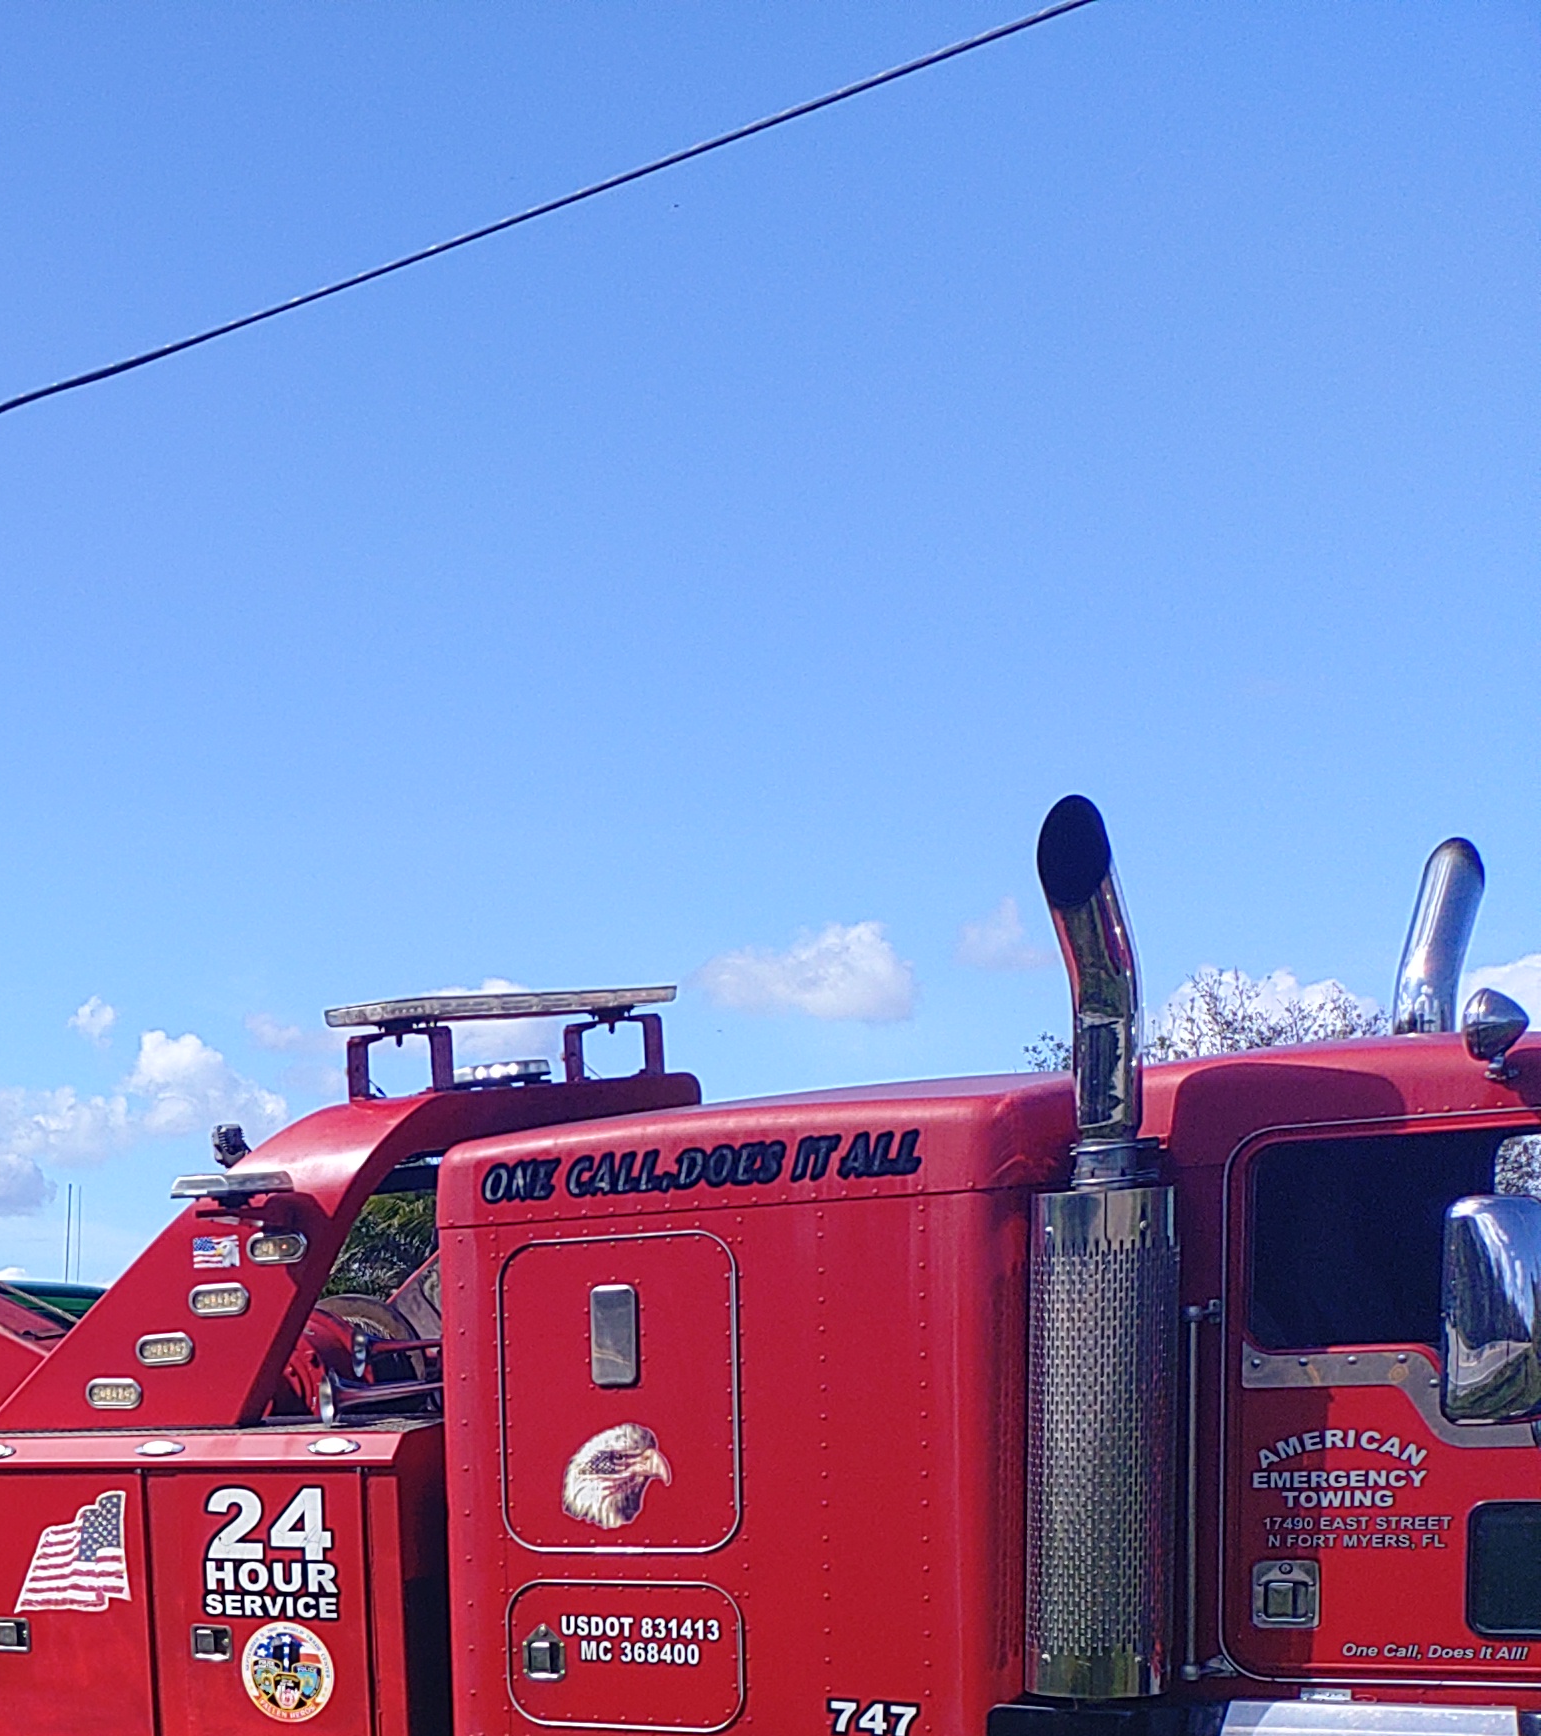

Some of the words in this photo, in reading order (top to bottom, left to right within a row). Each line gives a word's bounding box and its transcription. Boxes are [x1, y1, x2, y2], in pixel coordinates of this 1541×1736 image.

[483, 1159, 559, 1203] ONE
[791, 1134, 842, 1182] IT
[839, 1129, 922, 1179] ALL
[1257, 1428, 1429, 1470] AMERICAN
[1251, 1469, 1428, 1490] EMERGENCY
[1281, 1490, 1394, 1508] TOWING
[205, 1485, 333, 1562] 24
[1262, 1517, 1314, 1531] 17490
[1319, 1517, 1369, 1531] EAST
[1375, 1517, 1453, 1531] STREET
[1267, 1534, 1281, 1548] N
[1286, 1534, 1337, 1548] FORT
[1342, 1534, 1416, 1551] MYERS,
[1421, 1534, 1446, 1549] FL
[205, 1560, 338, 1594] HOUR
[205, 1594, 339, 1620] SERVICE
[560, 1615, 635, 1638] USDOT
[641, 1617, 720, 1642] 831413
[580, 1641, 613, 1663] MC
[620, 1642, 701, 1666] 368400
[1341, 1643, 1378, 1658] One
[1382, 1643, 1422, 1660] Call,
[1427, 1645, 1475, 1660] Does
[1479, 1645, 1494, 1660] It
[259, 1699, 288, 1718] FALLEN
